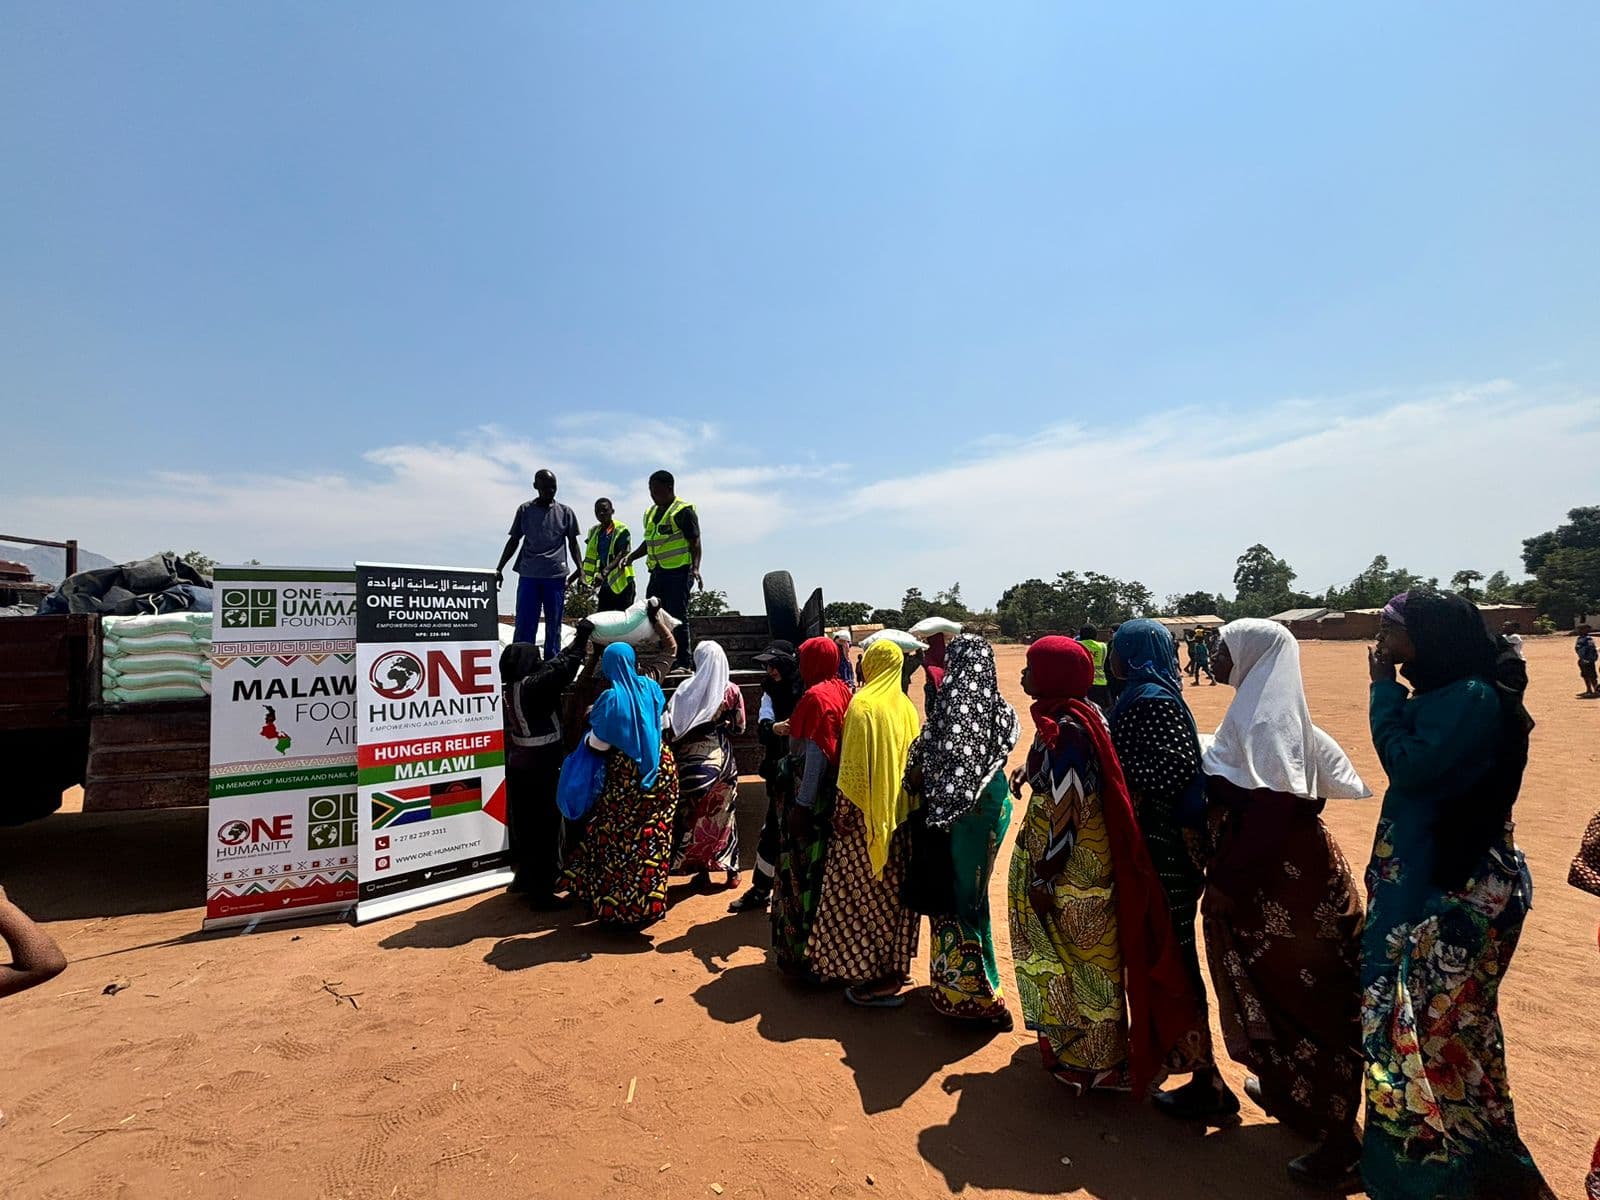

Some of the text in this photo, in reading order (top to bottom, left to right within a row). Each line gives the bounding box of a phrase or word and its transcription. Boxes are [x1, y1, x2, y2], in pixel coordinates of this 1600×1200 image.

[367, 577, 404, 590] الواحدة
[451, 580, 488, 593] المؤسسة
[283, 588, 322, 599] ONE
[366, 595, 490, 609] ONE HUMANITY
[282, 600, 357, 616] UMMA
[388, 610, 469, 620] FOUNDATION
[369, 649, 495, 700] ONE
[232, 675, 357, 702] MALAW
[369, 695, 500, 723] HUMANITY
[369, 722, 422, 733] EMPOWERING
[440, 718, 463, 726] AIDING
[464, 715, 495, 723] MANKIND
[374, 736, 492, 761] HUNGER RELIEF
[394, 755, 476, 780] MALAWI
[215, 783, 225, 791] IN
[225, 780, 261, 789] MEMORY
[275, 775, 310, 784] MUSTAFA
[217, 814, 293, 846] ONE
[418, 830, 431, 839] 239
[431, 828, 447, 836] 3311
[216, 840, 291, 858] HUMANITY
[395, 839, 482, 864] WWW.ONE-HUMANITY.NET
